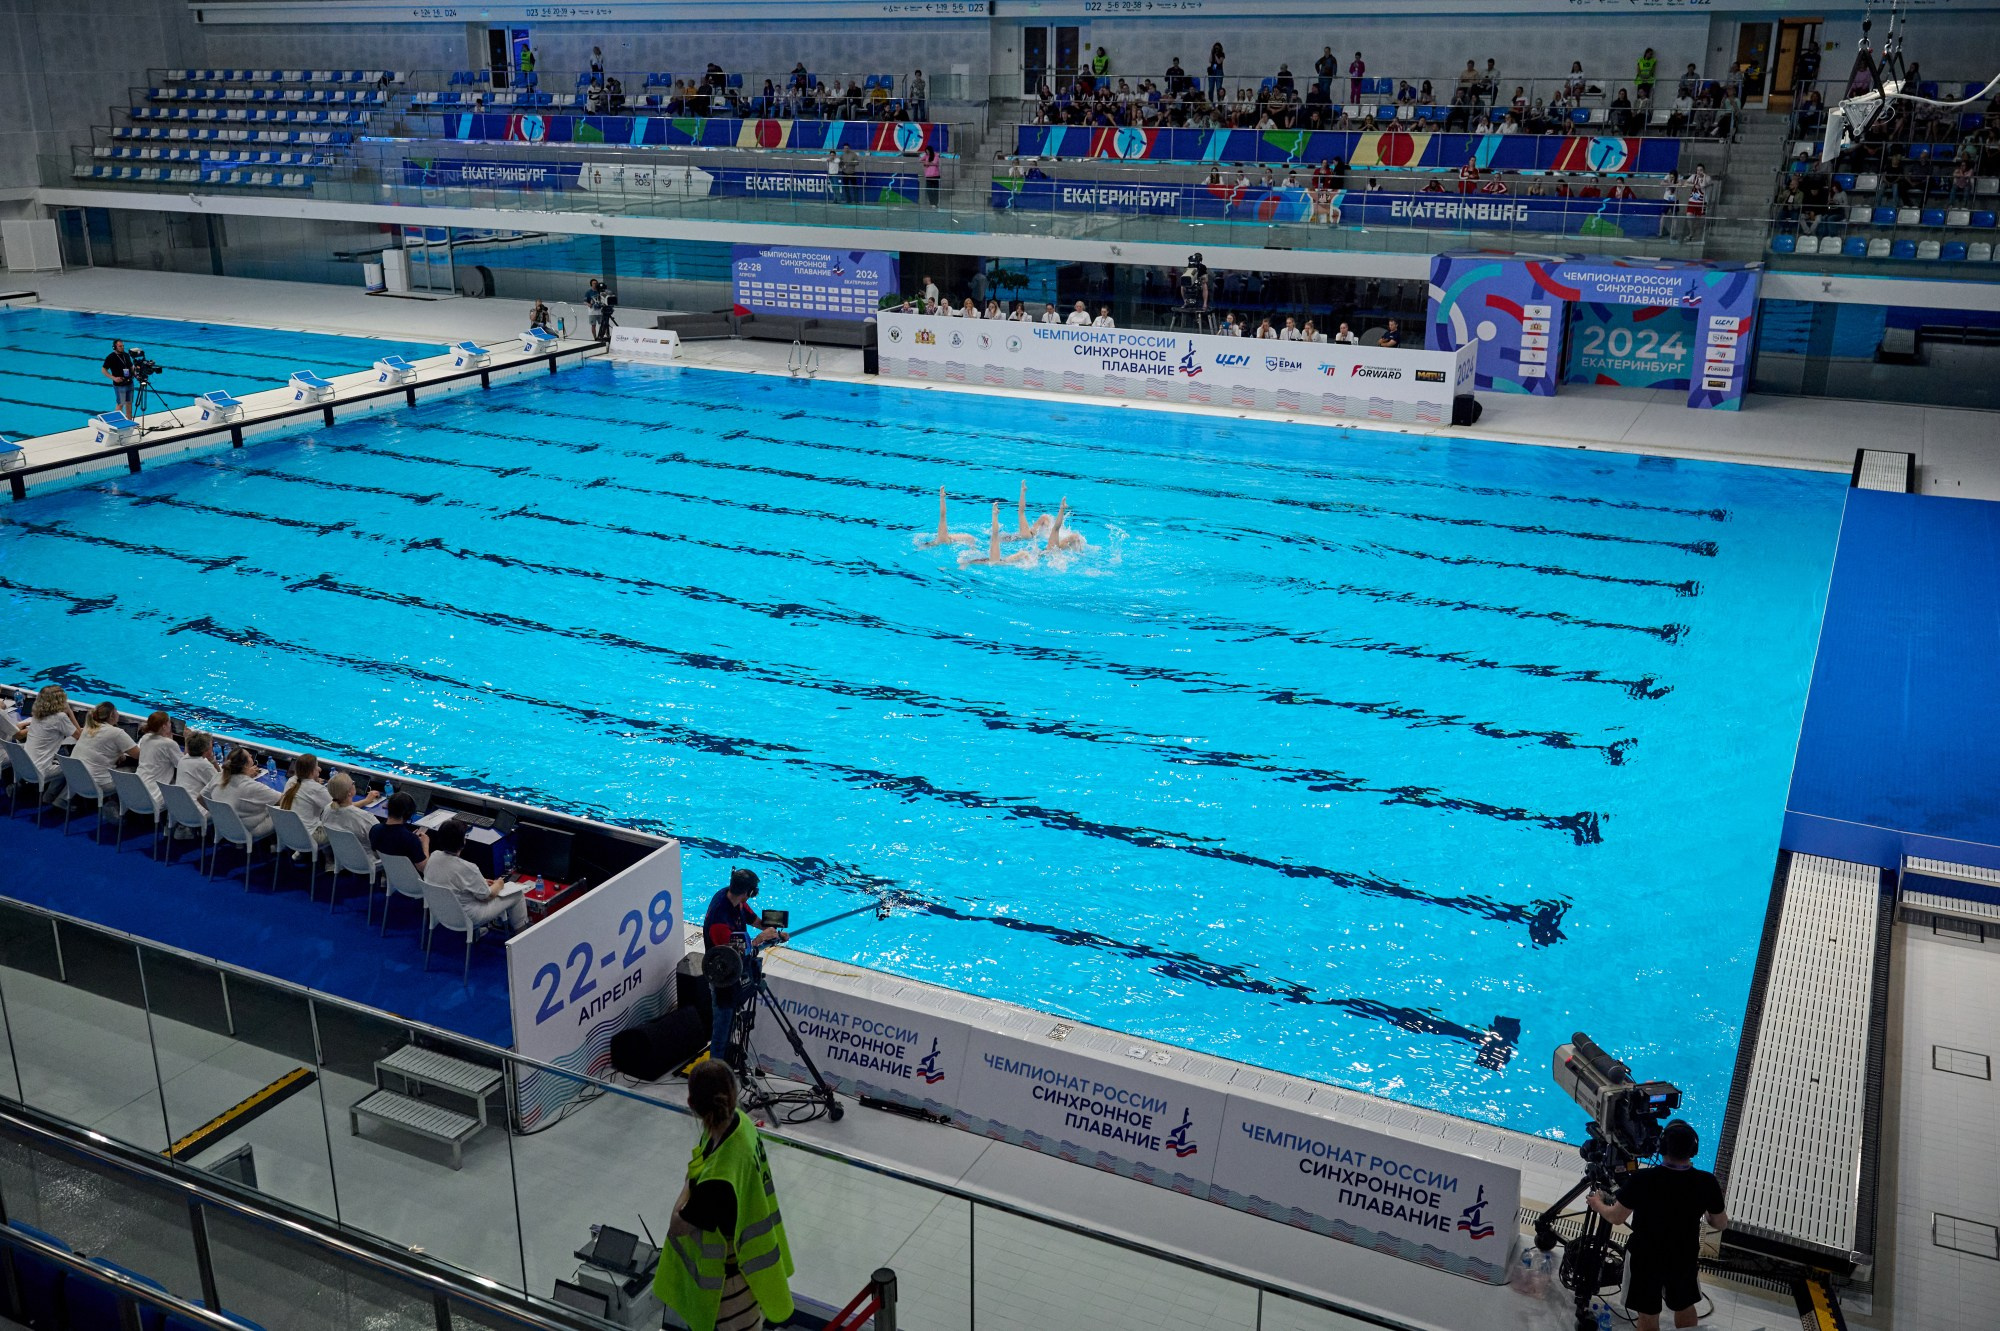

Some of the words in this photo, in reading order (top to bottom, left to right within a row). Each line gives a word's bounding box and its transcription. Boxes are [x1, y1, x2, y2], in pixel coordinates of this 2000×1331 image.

[444, 9, 457, 17] D24
[526, 9, 539, 17] D23
[968, 3, 984, 12] D23
[1085, 2, 1102, 11] D22
[1063, 187, 1180, 207] ЕКАТЕРИНБУРГ
[1391, 200, 1528, 222] EKATERINBURG
[759, 250, 801, 260] ЧЕМПИОНАТ
[801, 253, 831, 261] РОССИИ
[780, 259, 827, 268] СИНХРОННОЕ
[738, 262, 762, 271] 22-28
[794, 267, 832, 277] ПЛАВАНИЕ
[855, 270, 878, 279] 2024
[1563, 271, 1633, 284] ЧЕМПИОНАТ
[1633, 275, 1682, 286] РОССИИ
[1596, 283, 1673, 296] СИНХРОННОЕ
[1618, 294, 1679, 307] ПЛАВАНИЕ
[1033, 328, 1116, 345] ЧЕМПИОНАТ
[1118, 334, 1176, 349] РОССИИ
[1582, 325, 1687, 361] 2024
[1073, 344, 1167, 362] СИНХРОННОЕ
[1102, 360, 1175, 376] ПЛАВАНИЕ
[1351, 364, 1402, 380] FORWARD
[1457, 358, 1474, 386] 2024
[1581, 357, 1686, 374] ЕКАТЕРИНБУРГ
[532, 889, 674, 1026] 22-28
[578, 968, 642, 1026] АПРЕЛЯ
[851, 1016, 919, 1045] РОССИИ
[798, 1021, 906, 1060] СИНХРОННОЕ
[827, 1045, 913, 1079] ПЛАВАНИЕ
[984, 1052, 1090, 1093] ЧЕМПИОНАТ
[1092, 1082, 1168, 1115] РОССИИ
[1032, 1085, 1153, 1130] СИНХРОННОЕ
[1065, 1112, 1161, 1152] ПЛАВАНИЕ
[1241, 1121, 1366, 1168] ЧЕМПИОНАТ
[1369, 1155, 1459, 1193] РОССИИ
[1299, 1158, 1442, 1209] СИНХРОННОЕ
[1338, 1188, 1452, 1233] ПЛАВАНИЕ
